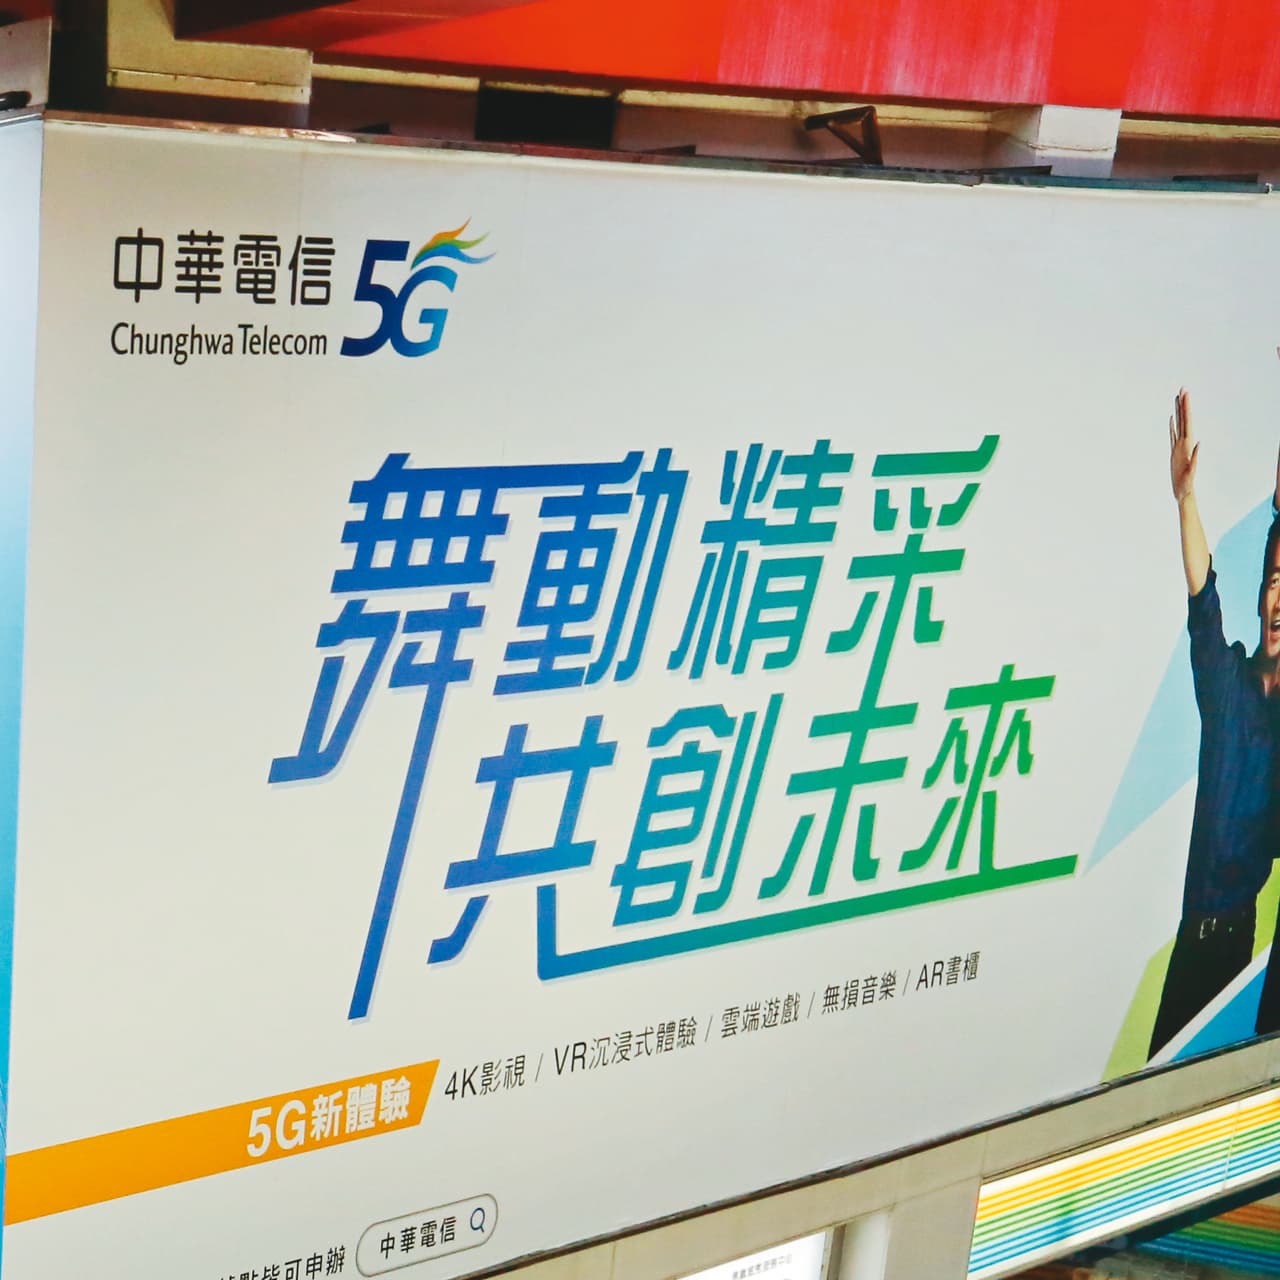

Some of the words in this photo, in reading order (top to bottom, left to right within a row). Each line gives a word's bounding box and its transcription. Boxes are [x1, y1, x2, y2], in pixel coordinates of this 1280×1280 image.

[110, 322, 233, 365] Chunghwa
[238, 324, 327, 356] Telecom
[112, 227, 336, 306] 中華電信
[340, 237, 458, 358] 5G
[268, 433, 1000, 1020] 舞動精采
[427, 663, 1078, 982] 共創未來
[444, 1054, 526, 1101] 4K影視
[554, 1016, 698, 1077] VR沉浸式體驗
[720, 992, 800, 1041] 雲端遊戲
[822, 970, 897, 1015] 無損音樂
[916, 950, 981, 991] AR書櫃
[246, 1075, 412, 1158] 5G新體驗
[379, 1216, 458, 1260] 中華電信
